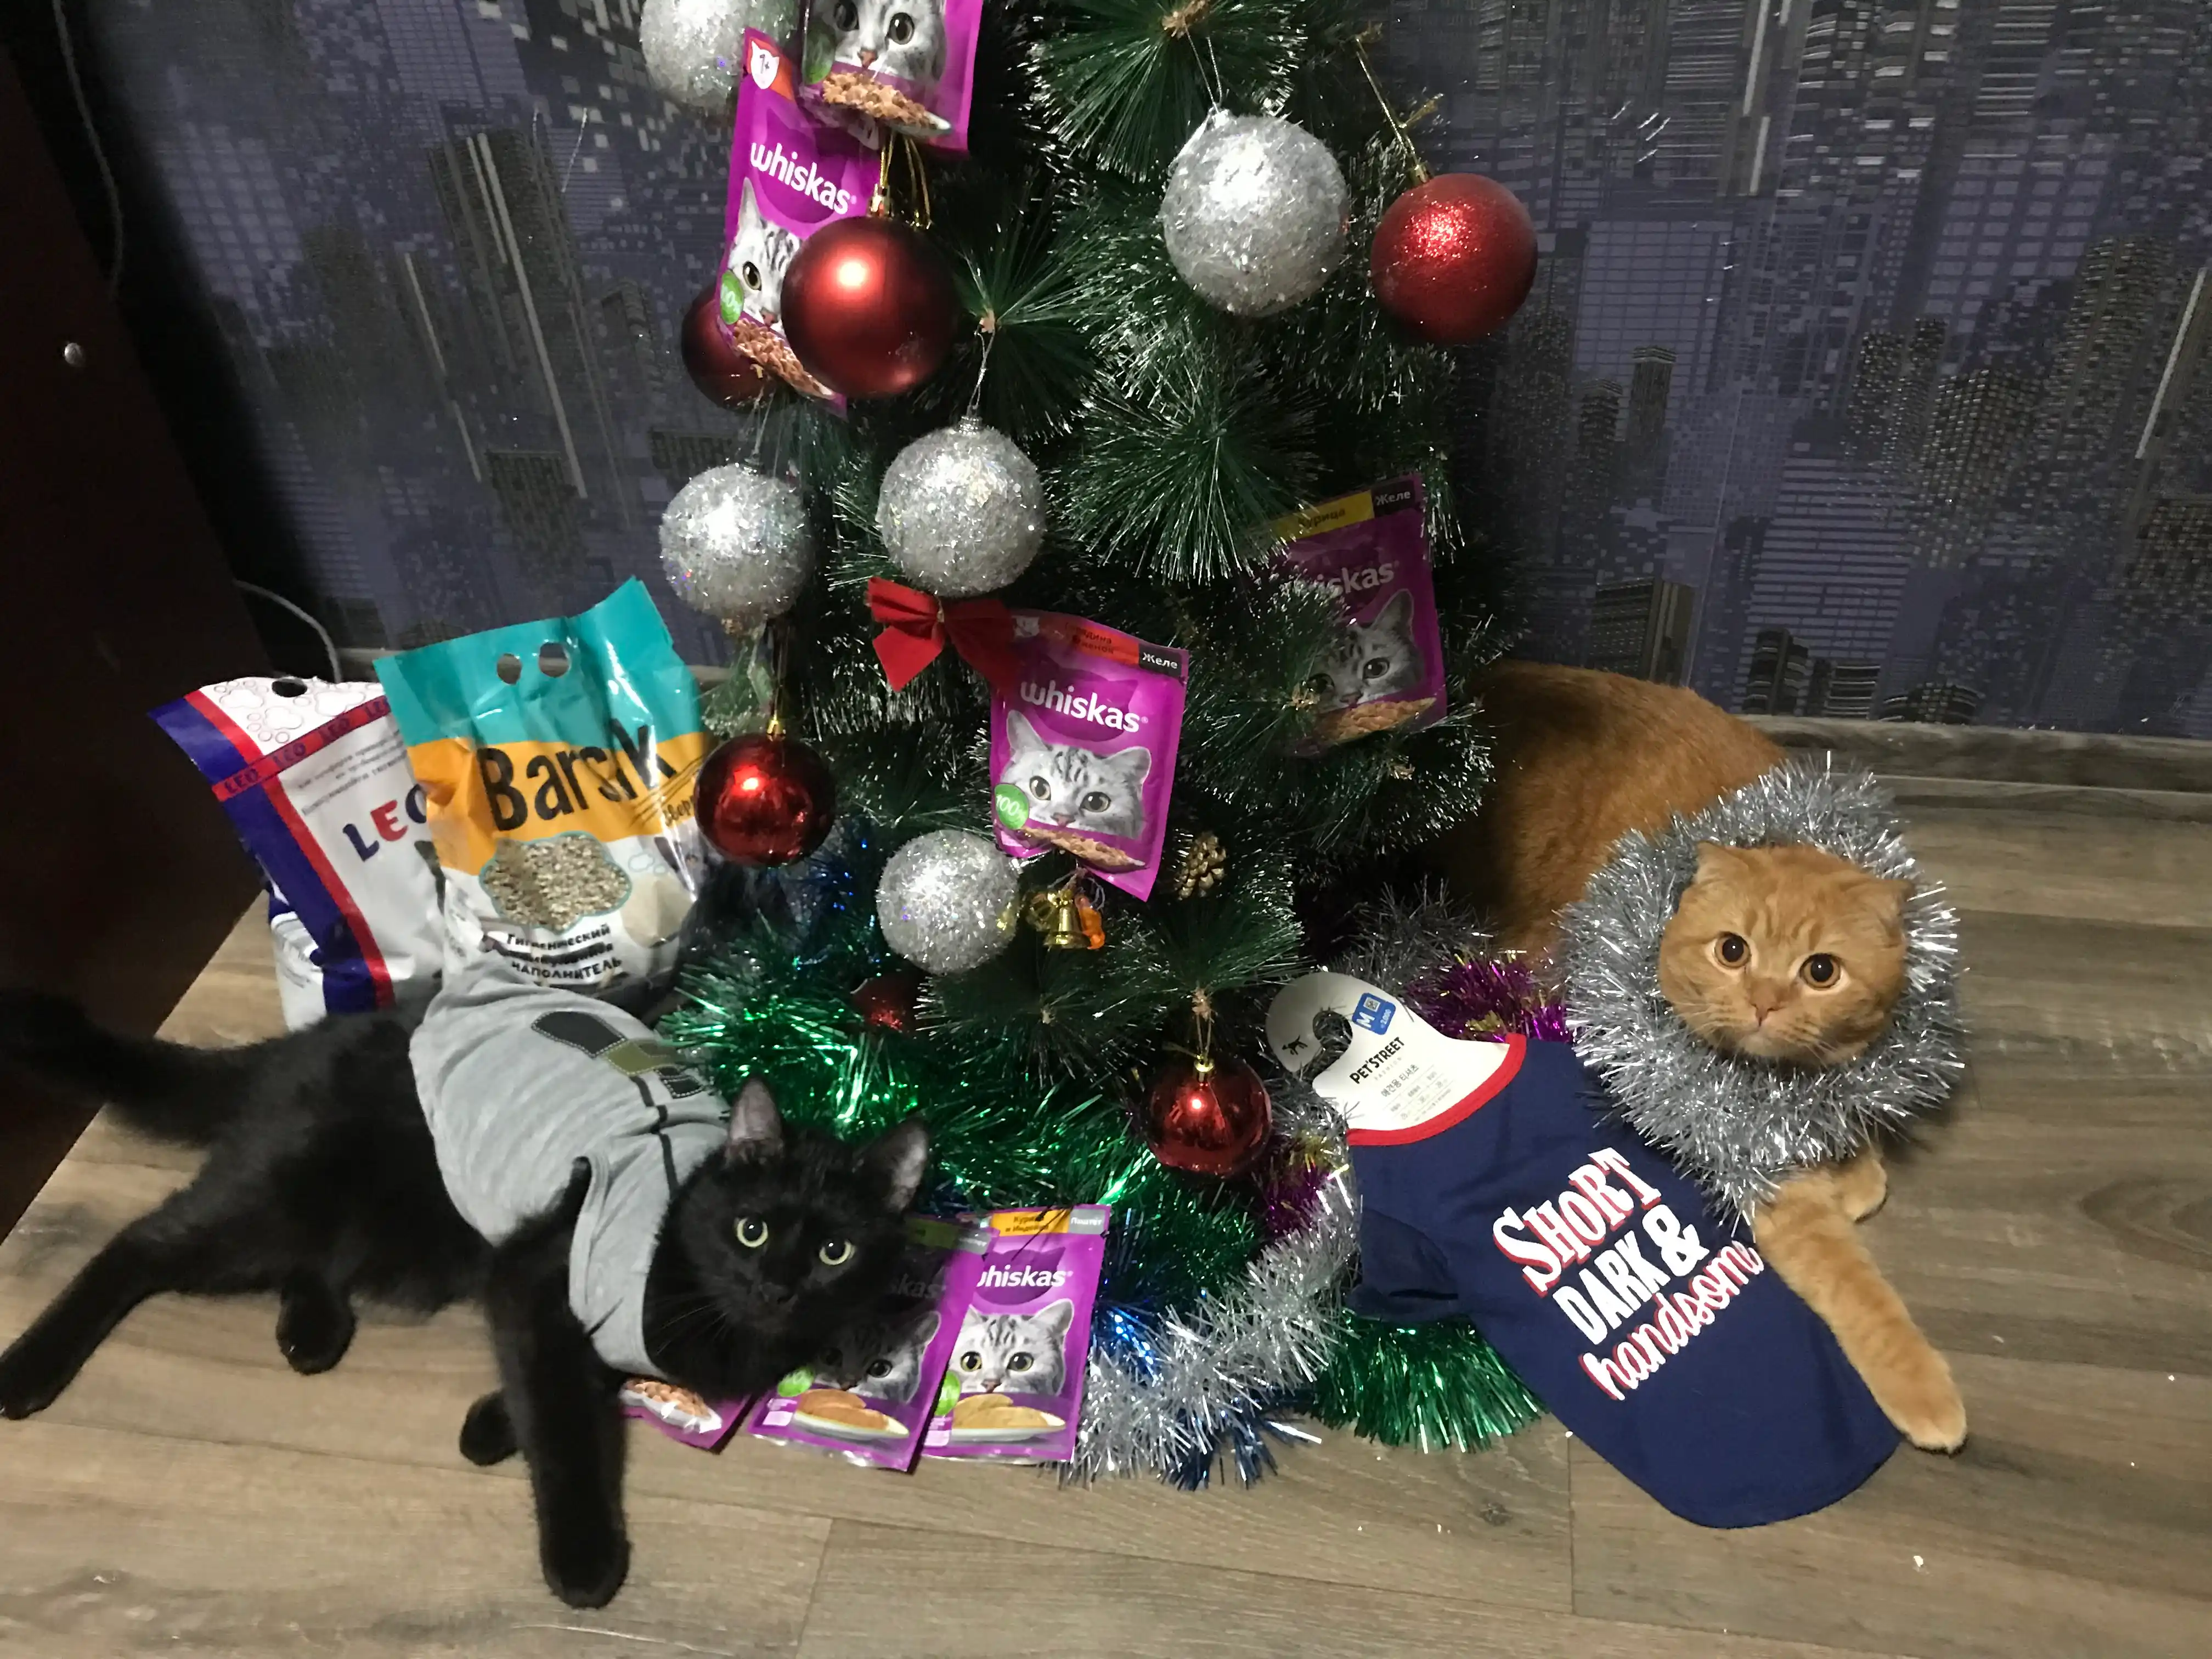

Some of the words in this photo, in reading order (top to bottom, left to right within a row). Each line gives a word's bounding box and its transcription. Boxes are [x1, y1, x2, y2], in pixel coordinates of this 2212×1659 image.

[750, 141, 849, 215] whiskas
[1376, 491, 1411, 506] Желе
[1142, 652, 1178, 669] Желе
[1020, 679, 1141, 733] whiskas
[224, 768, 258, 793] LEO
[1356, 1012, 1375, 1028] M
[1349, 1036, 1405, 1085] PET'STREET
[1492, 1147, 1662, 1298] SHORT
[1552, 1230, 1672, 1346] DARK
[1641, 1204, 1710, 1277] &
[1578, 1240, 1764, 1401] handsome
